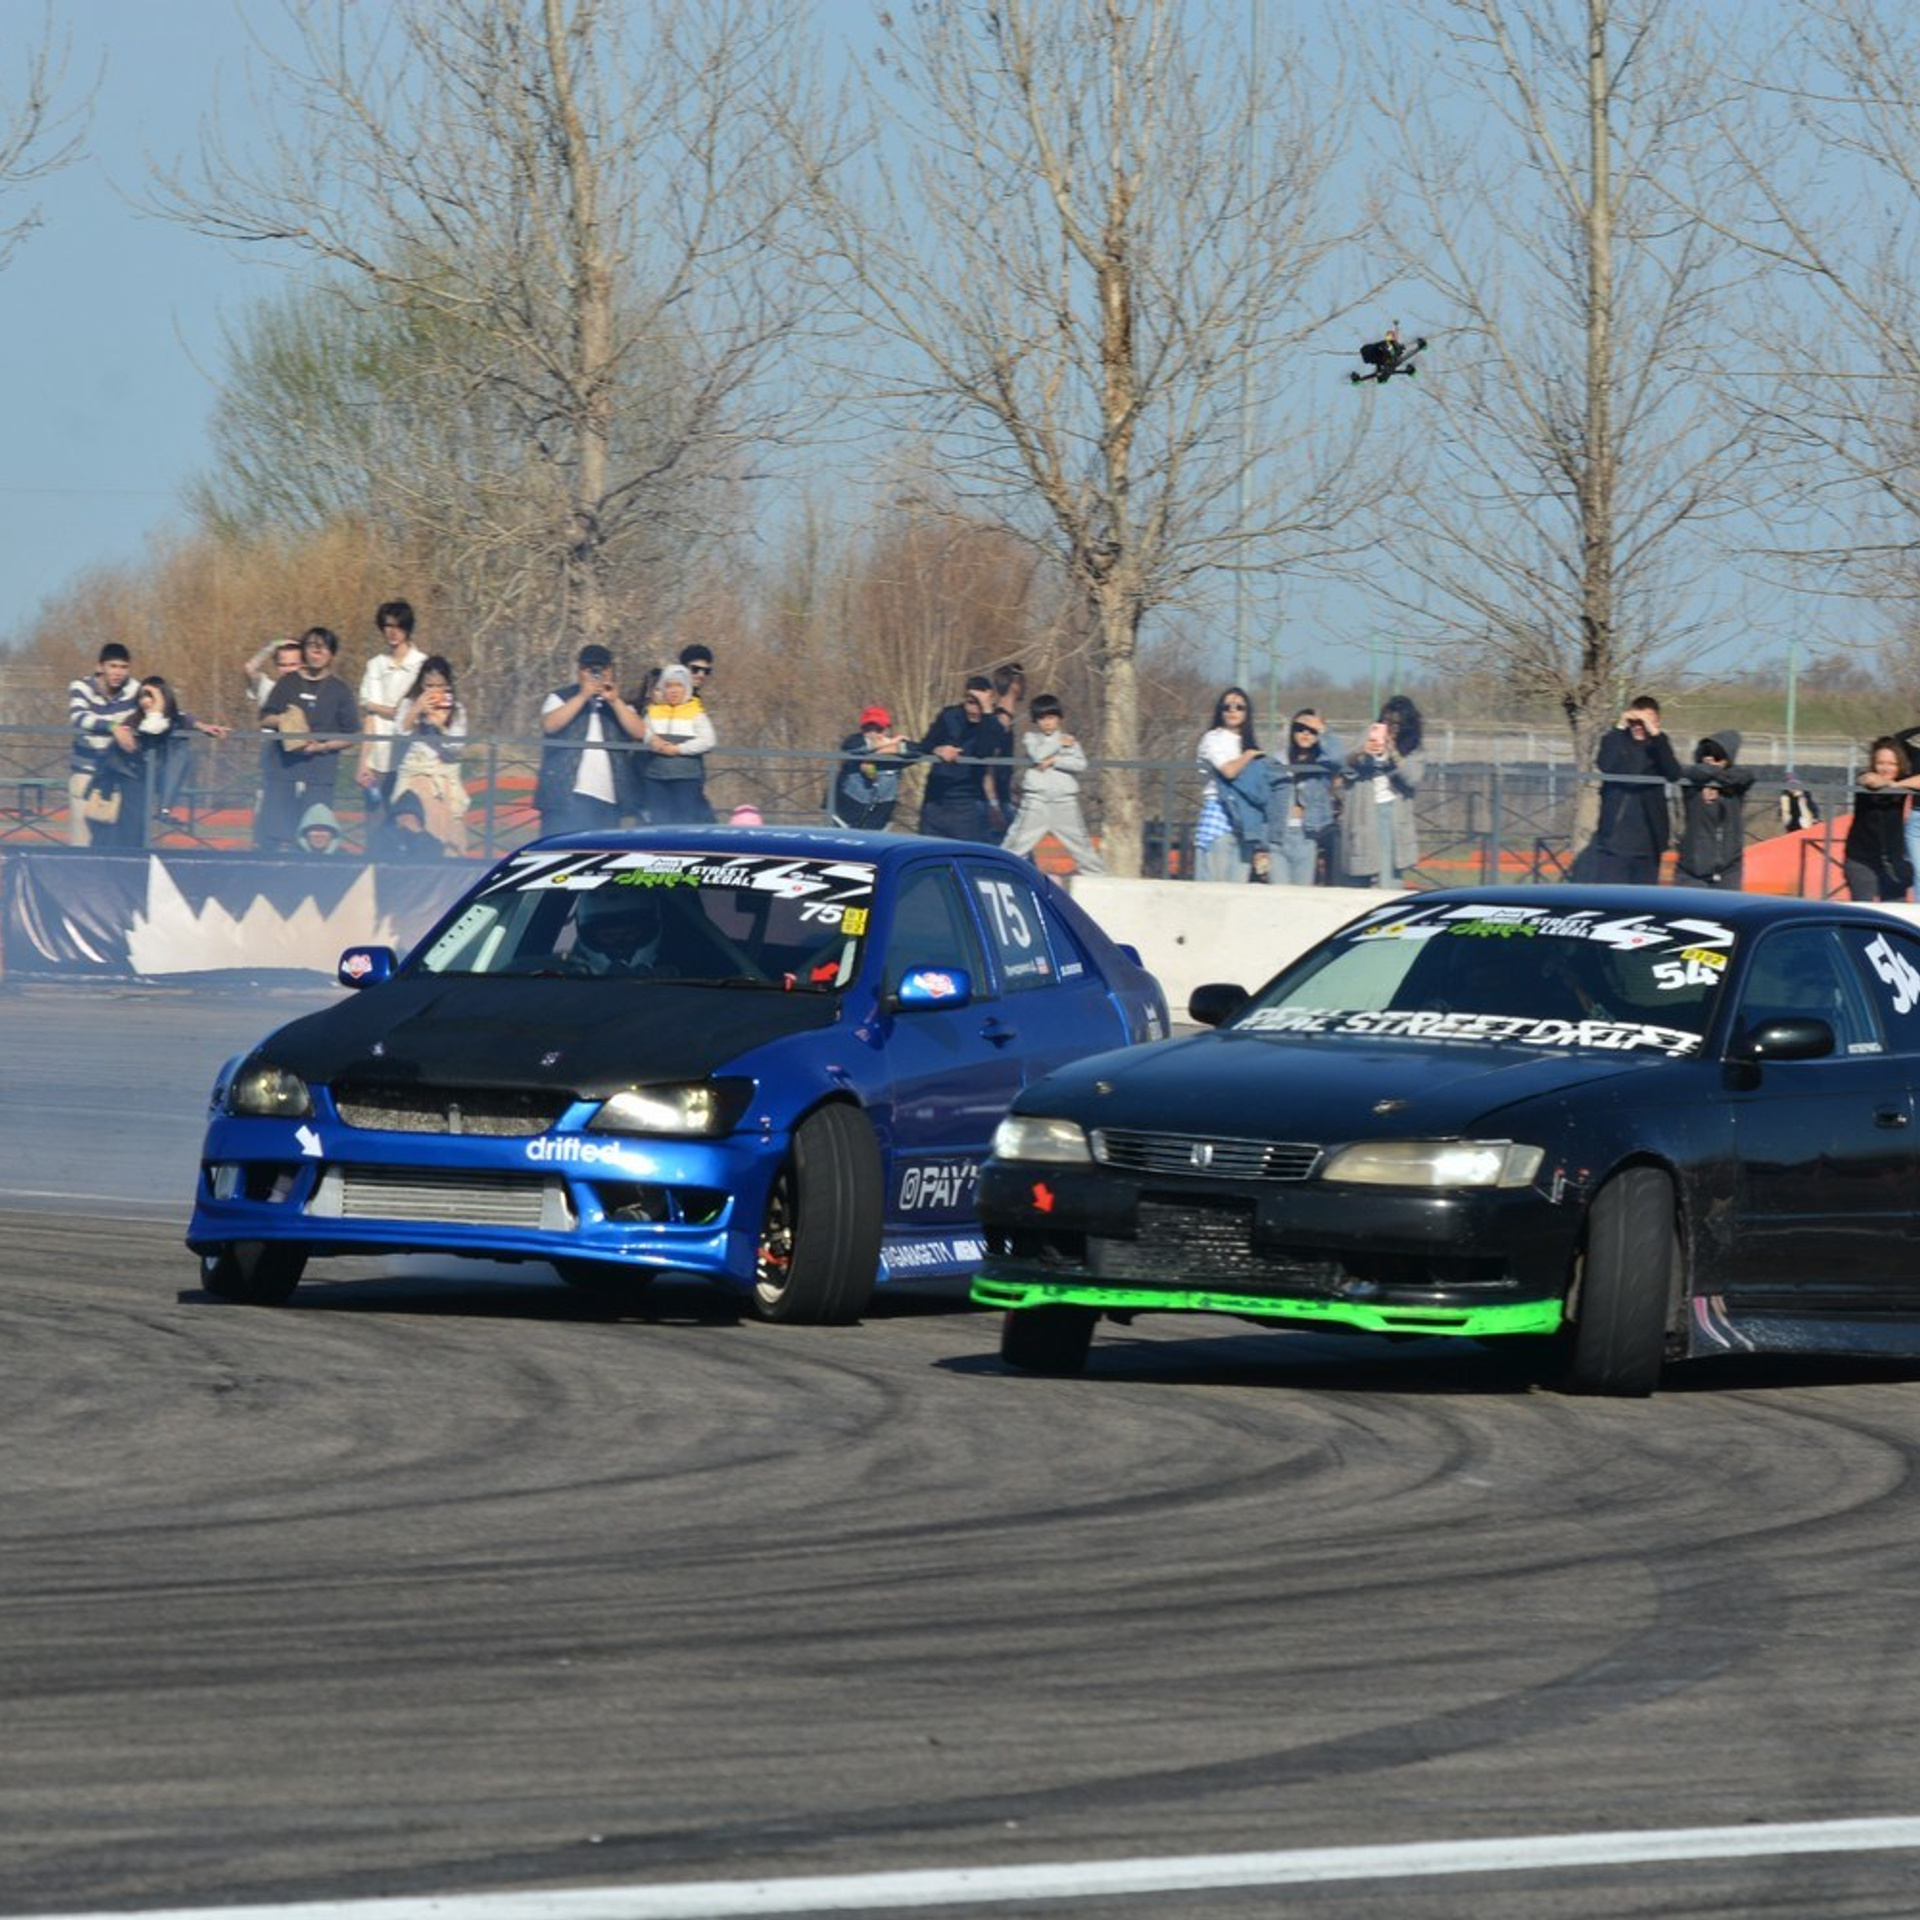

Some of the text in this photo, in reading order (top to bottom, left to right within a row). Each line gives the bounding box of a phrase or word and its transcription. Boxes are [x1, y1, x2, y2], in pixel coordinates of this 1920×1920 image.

[690, 866, 750, 877] STREET
[701, 874, 751, 887] LEGAL
[799, 902, 845, 924] 75
[976, 879, 1032, 948] 75
[1528, 917, 1593, 927] STREET
[1537, 926, 1591, 937] LEGAL
[1651, 960, 1719, 990] 54
[526, 1136, 619, 1164] drifted
